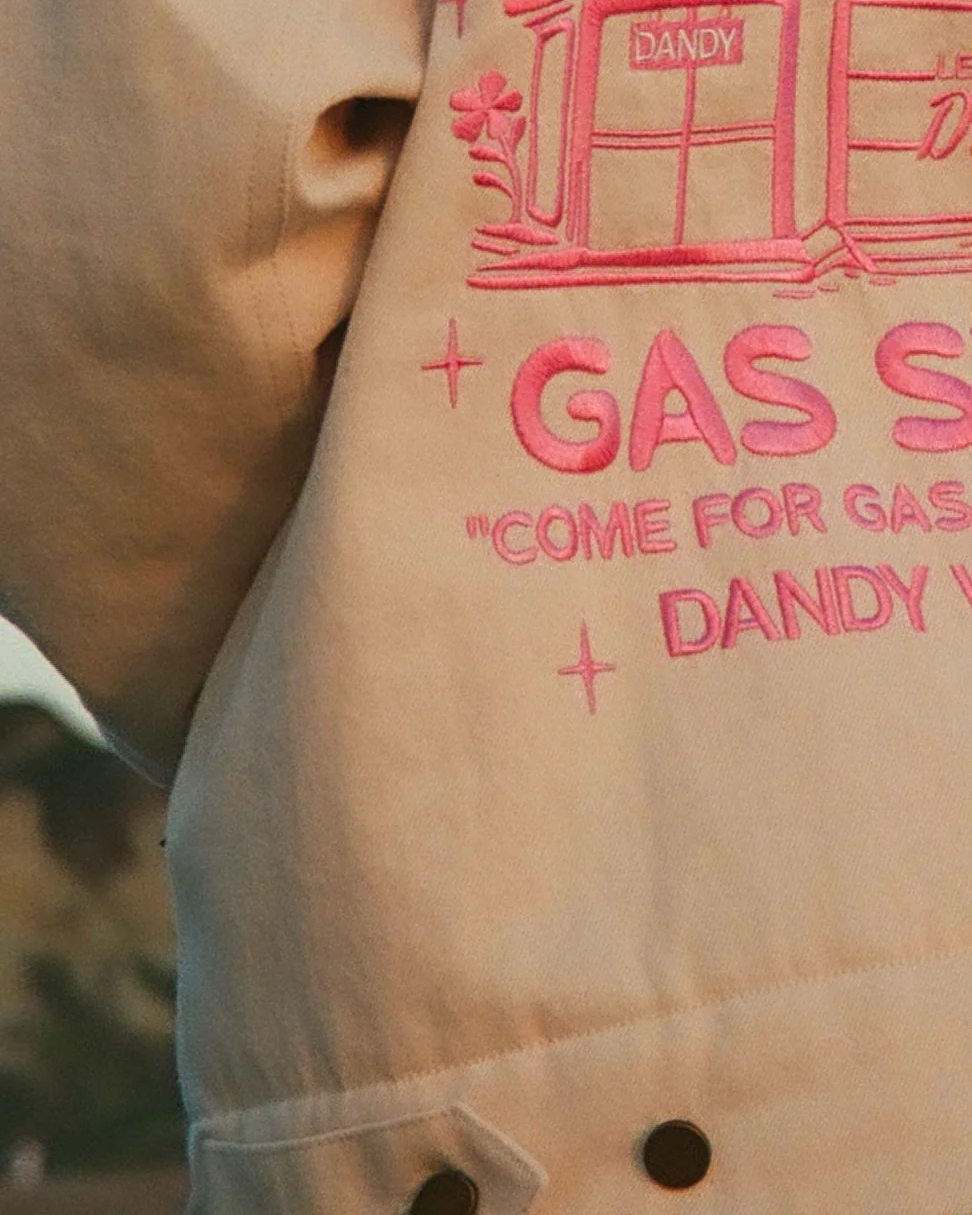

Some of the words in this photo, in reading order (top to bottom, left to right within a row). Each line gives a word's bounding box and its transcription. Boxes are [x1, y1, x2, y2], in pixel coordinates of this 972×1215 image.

[634, 27, 736, 63] DANDY
[510, 323, 838, 475] GAS
[465, 498, 678, 566] "COME
[691, 482, 828, 549] FOR
[658, 564, 930, 658] DANDY
